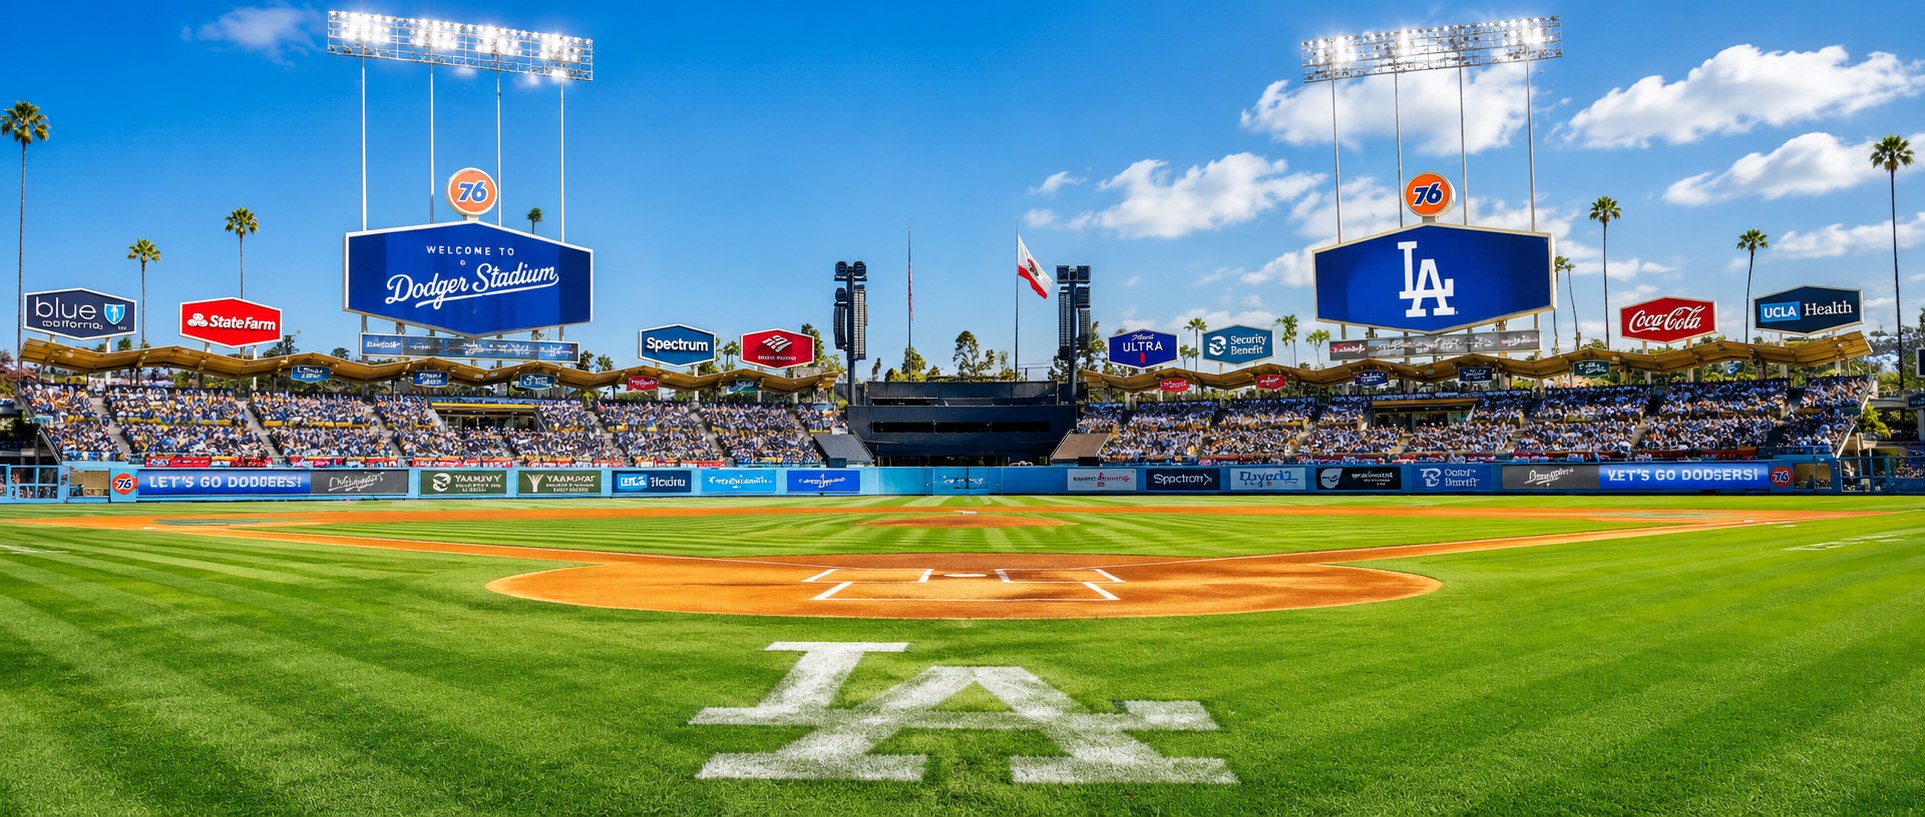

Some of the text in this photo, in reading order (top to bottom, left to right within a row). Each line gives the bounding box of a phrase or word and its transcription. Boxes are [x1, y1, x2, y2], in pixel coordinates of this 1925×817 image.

[457, 180, 488, 203] 76
[1413, 182, 1444, 206] 76
[426, 245, 515, 256] WELCOME TO
[385, 258, 560, 311] Dodger Stadium
[1397, 240, 1455, 318] LA
[35, 296, 97, 320] blue
[1763, 301, 1852, 321] UCLA Health
[1629, 305, 1706, 333] Coca-Cola
[646, 337, 709, 353] Spectrum
[1122, 341, 1164, 352] ULTRA
[1230, 333, 1267, 346] Security
[1230, 345, 1264, 355] Benefit
[149, 476, 195, 488] LET'S
[199, 476, 221, 488] GO
[1655, 469, 1676, 481] GO
[1773, 471, 1790, 483] 76
[116, 479, 133, 490] 76
[687, 641, 1240, 784] LA
